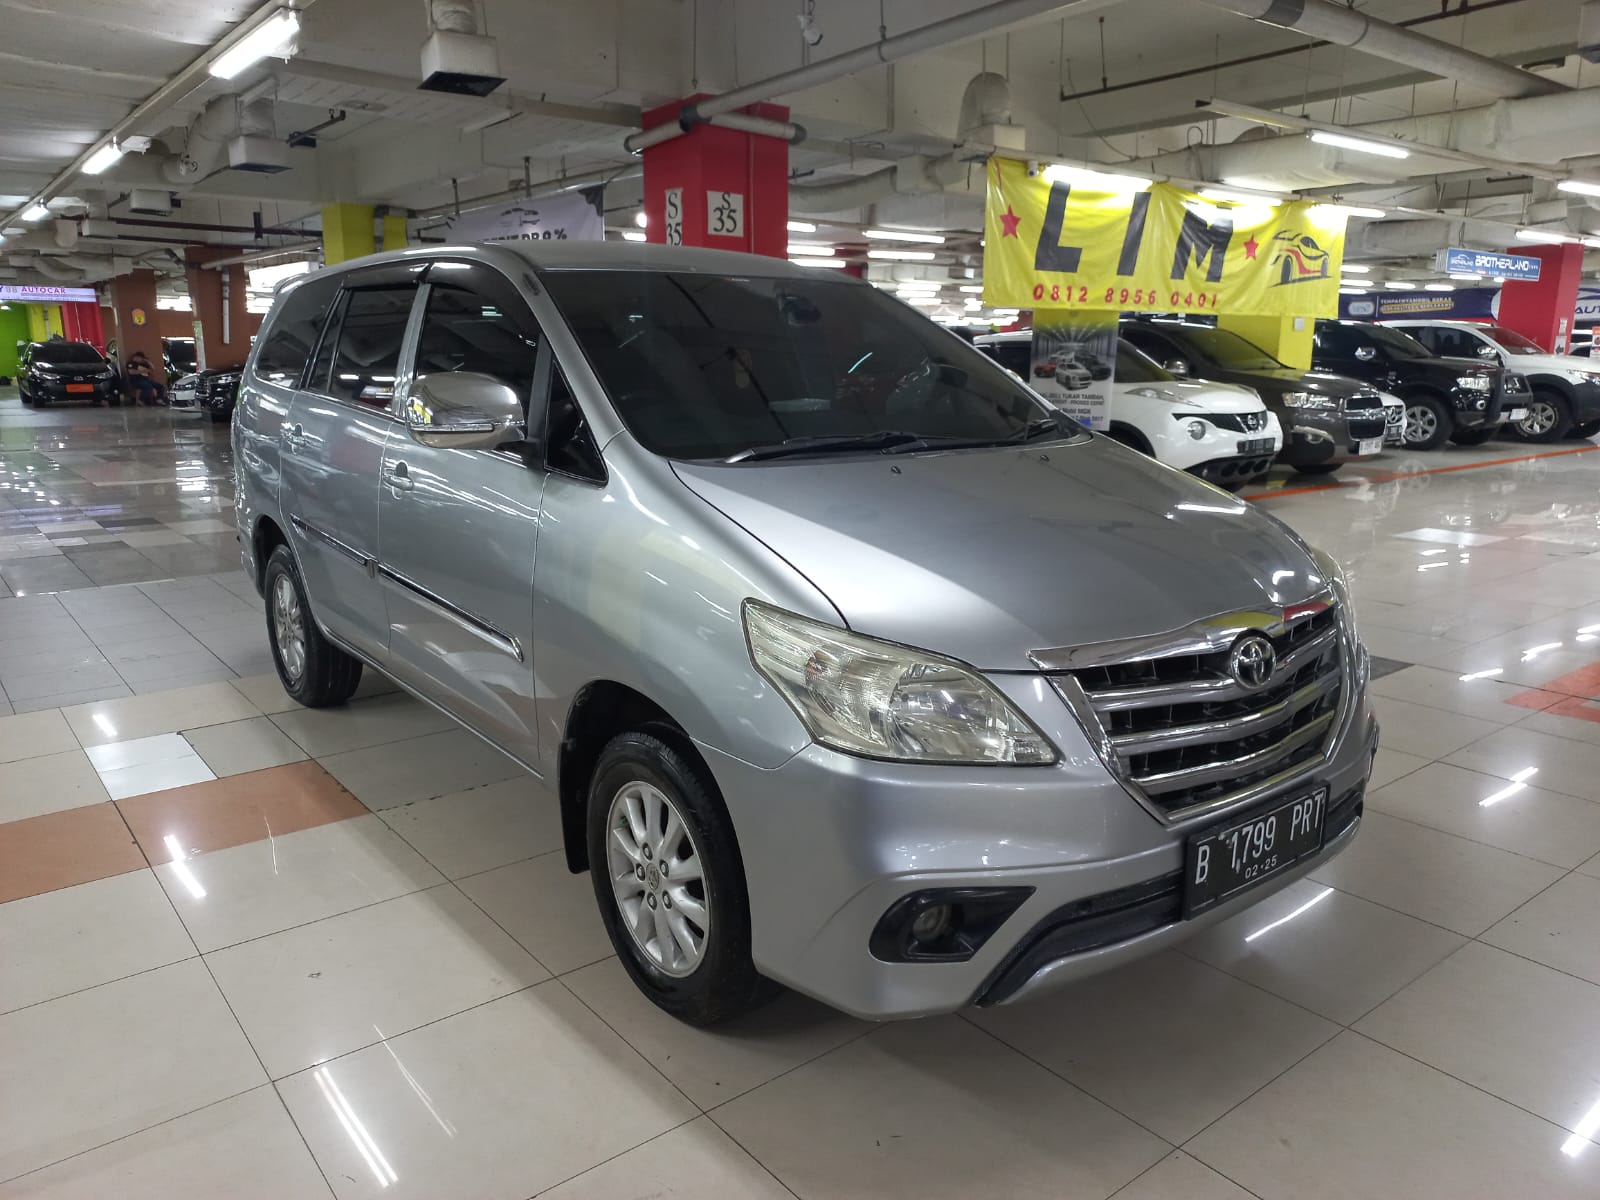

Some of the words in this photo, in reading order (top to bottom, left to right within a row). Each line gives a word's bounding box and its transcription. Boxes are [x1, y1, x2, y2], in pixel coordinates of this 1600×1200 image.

[668, 192, 678, 219] S
[721, 192, 731, 210] S
[712, 207, 737, 233] 35
[1035, 180, 1233, 283] LIM
[1475, 255, 1529, 271] BROTHERLAND
[1032, 284, 1089, 303] 0812
[1104, 287, 1157, 306] 8956
[1169, 291, 1218, 309] 0401
[1194, 844, 1211, 885] B
[1230, 815, 1276, 870] 1799
[1289, 791, 1325, 841] PRT
